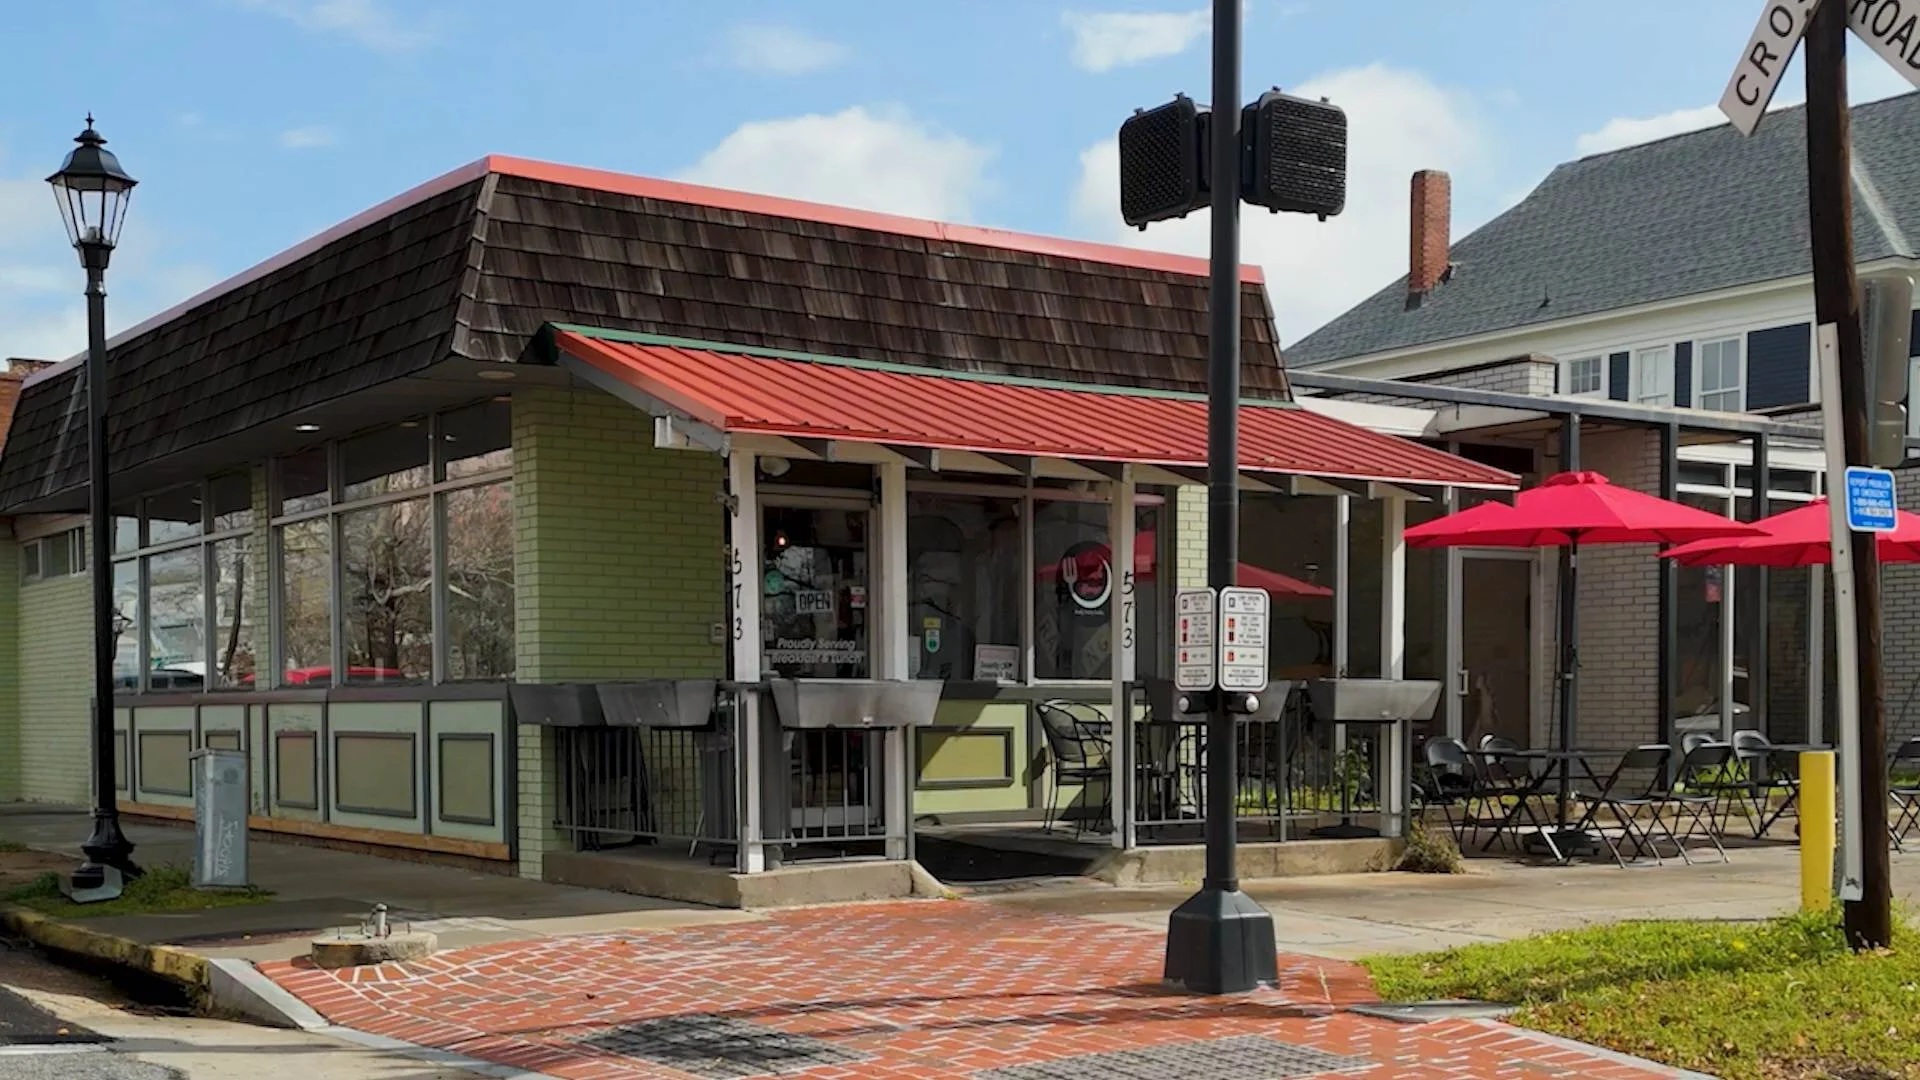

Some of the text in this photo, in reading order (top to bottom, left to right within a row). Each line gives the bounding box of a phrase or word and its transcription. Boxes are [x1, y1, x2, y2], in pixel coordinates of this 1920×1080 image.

[1736, 0, 1804, 106] CRO
[799, 591, 831, 610] OPEN
[1121, 570, 1135, 649] 573
[777, 637, 856, 653] Proudly Serving
